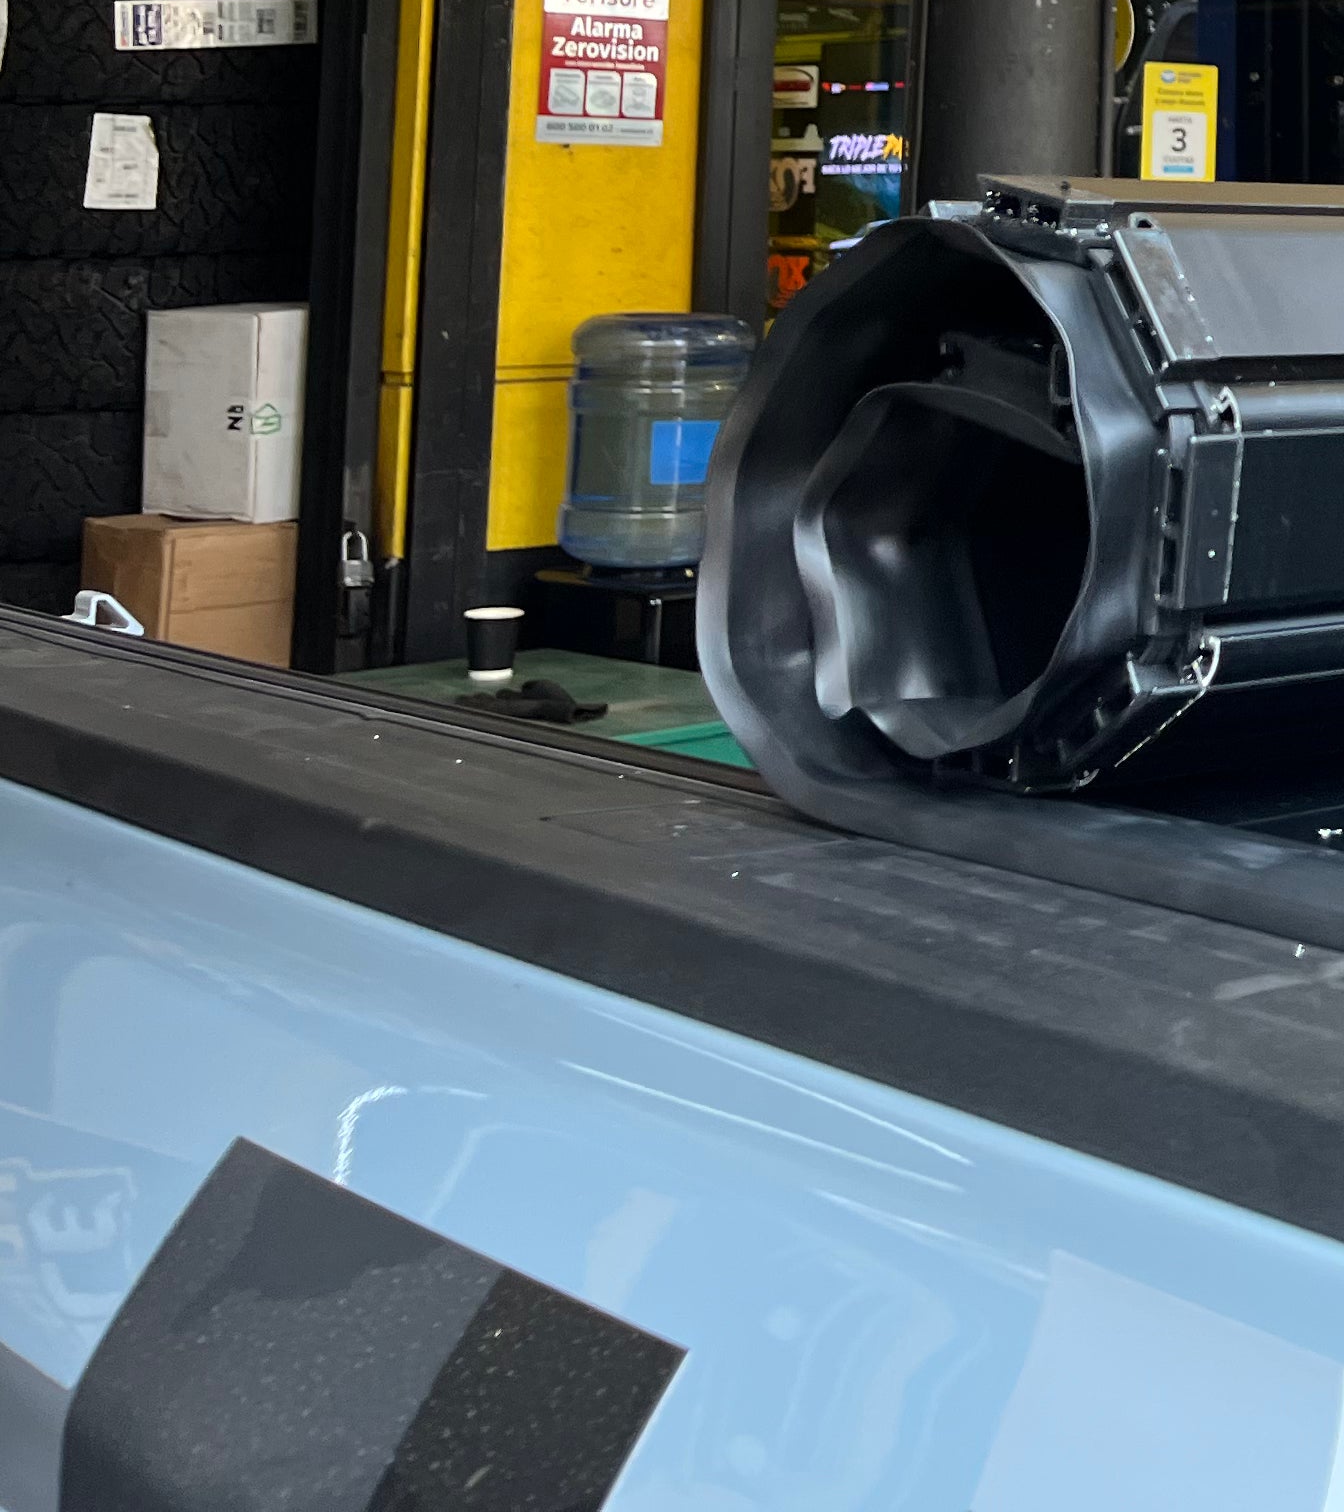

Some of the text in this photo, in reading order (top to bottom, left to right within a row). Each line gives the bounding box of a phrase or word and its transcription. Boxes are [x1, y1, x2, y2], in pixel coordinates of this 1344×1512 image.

[570, 16, 643, 40] Alarma
[552, 37, 659, 62] Zerovision
[1171, 128, 1187, 152] 3
